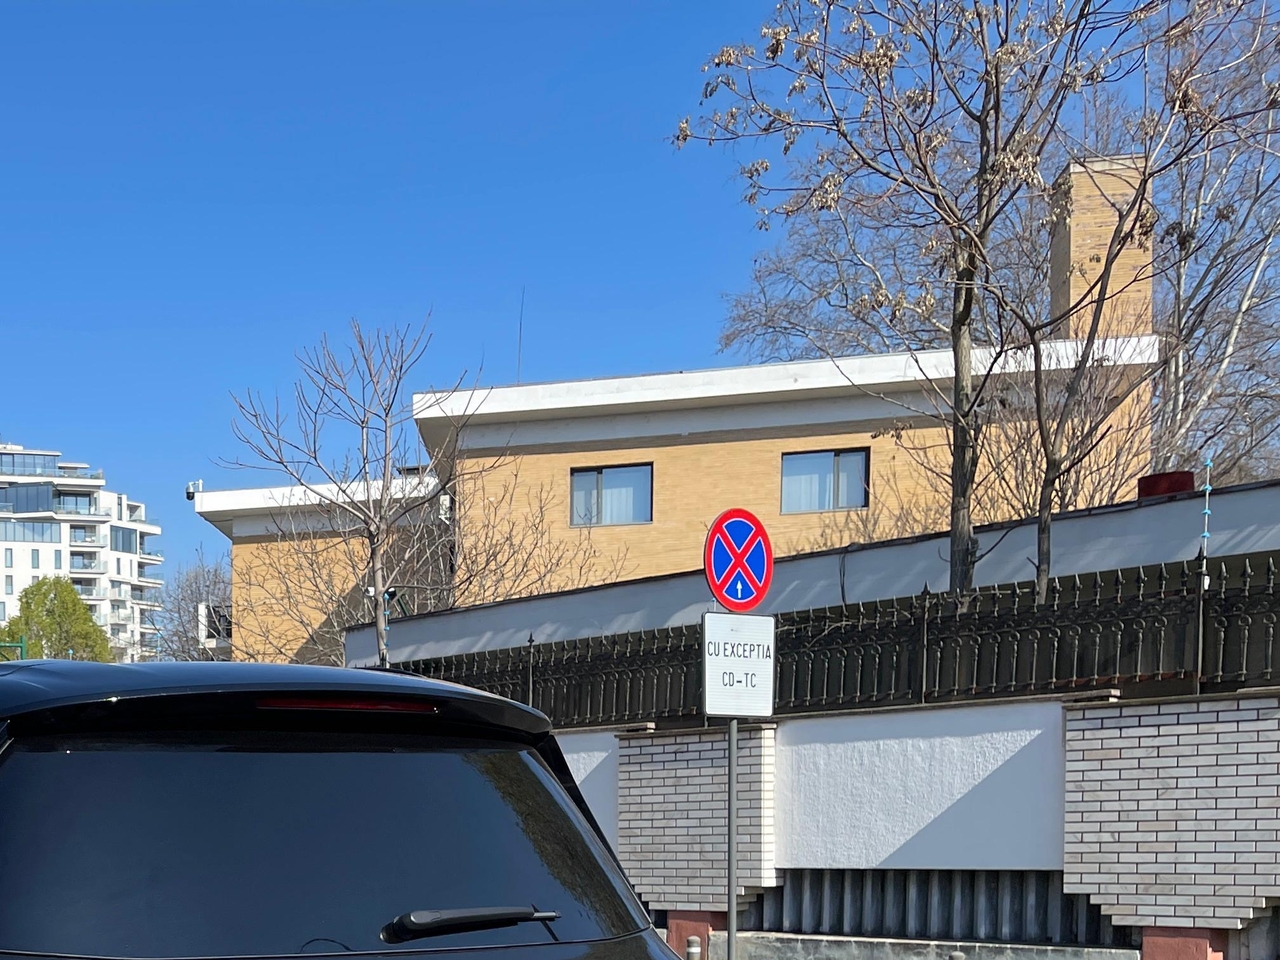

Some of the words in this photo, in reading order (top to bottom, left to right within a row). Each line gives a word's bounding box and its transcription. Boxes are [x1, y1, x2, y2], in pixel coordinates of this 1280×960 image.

[707, 641, 720, 657] CU
[723, 642, 771, 659] EXCEPTIA
[722, 671, 757, 688] CD-TC
